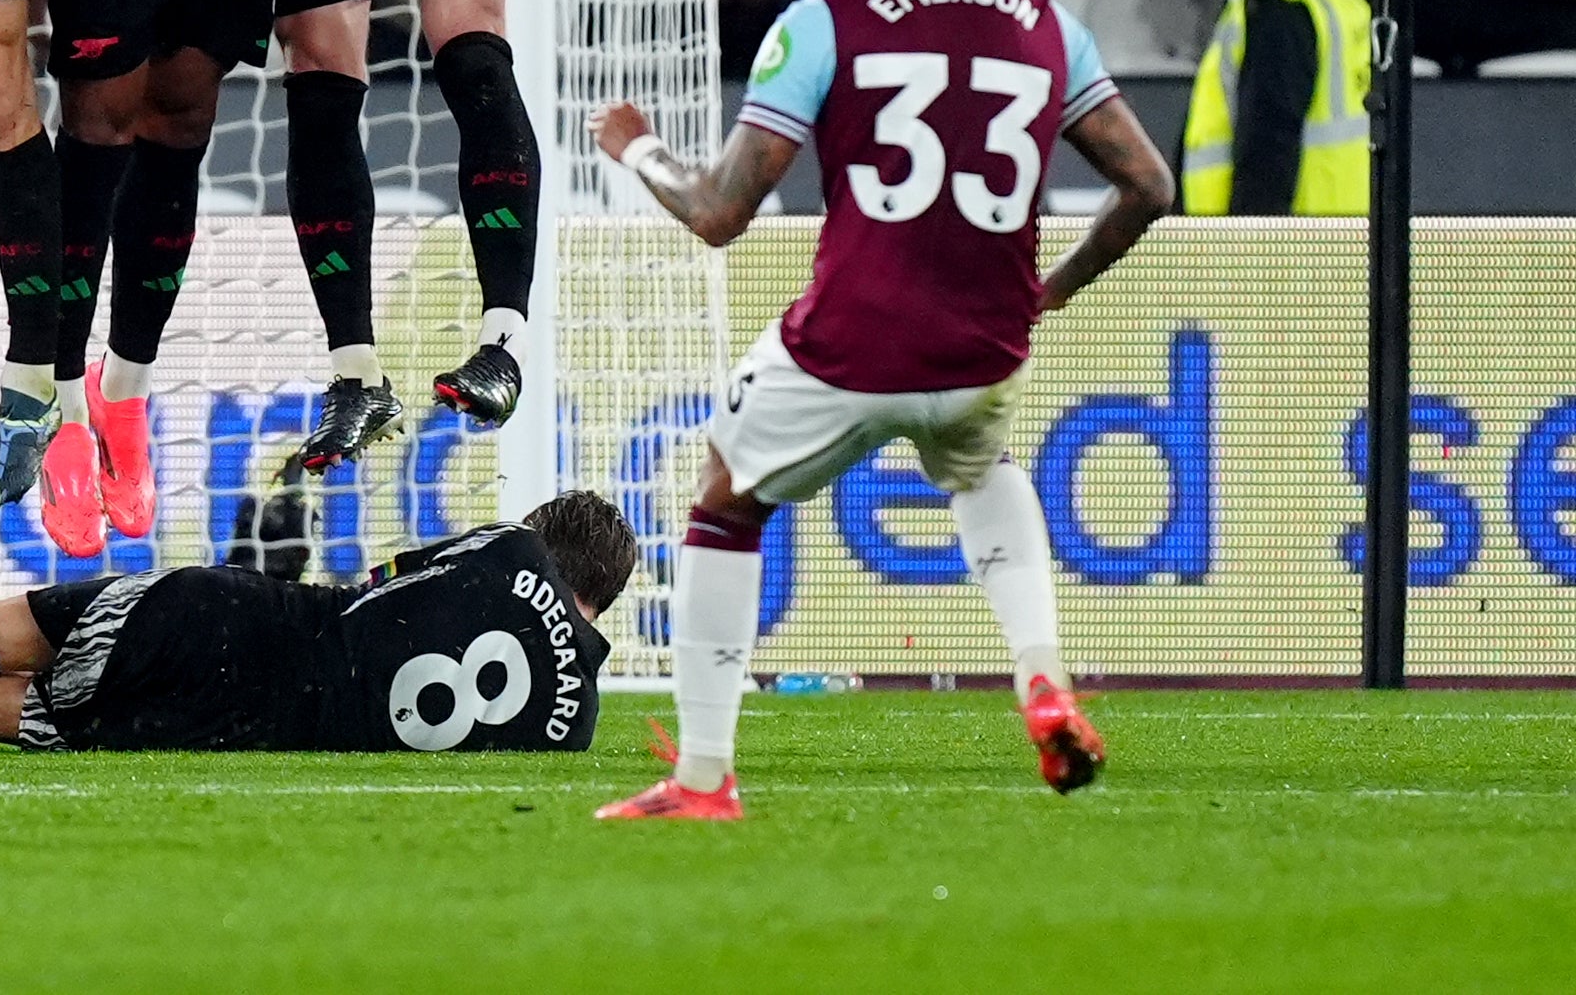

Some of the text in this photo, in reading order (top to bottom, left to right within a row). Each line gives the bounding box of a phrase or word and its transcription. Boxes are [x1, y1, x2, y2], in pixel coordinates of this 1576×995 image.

[846, 52, 1053, 234] 33
[389, 630, 532, 751] 8
[512, 568, 583, 743] ØDEGAARD
